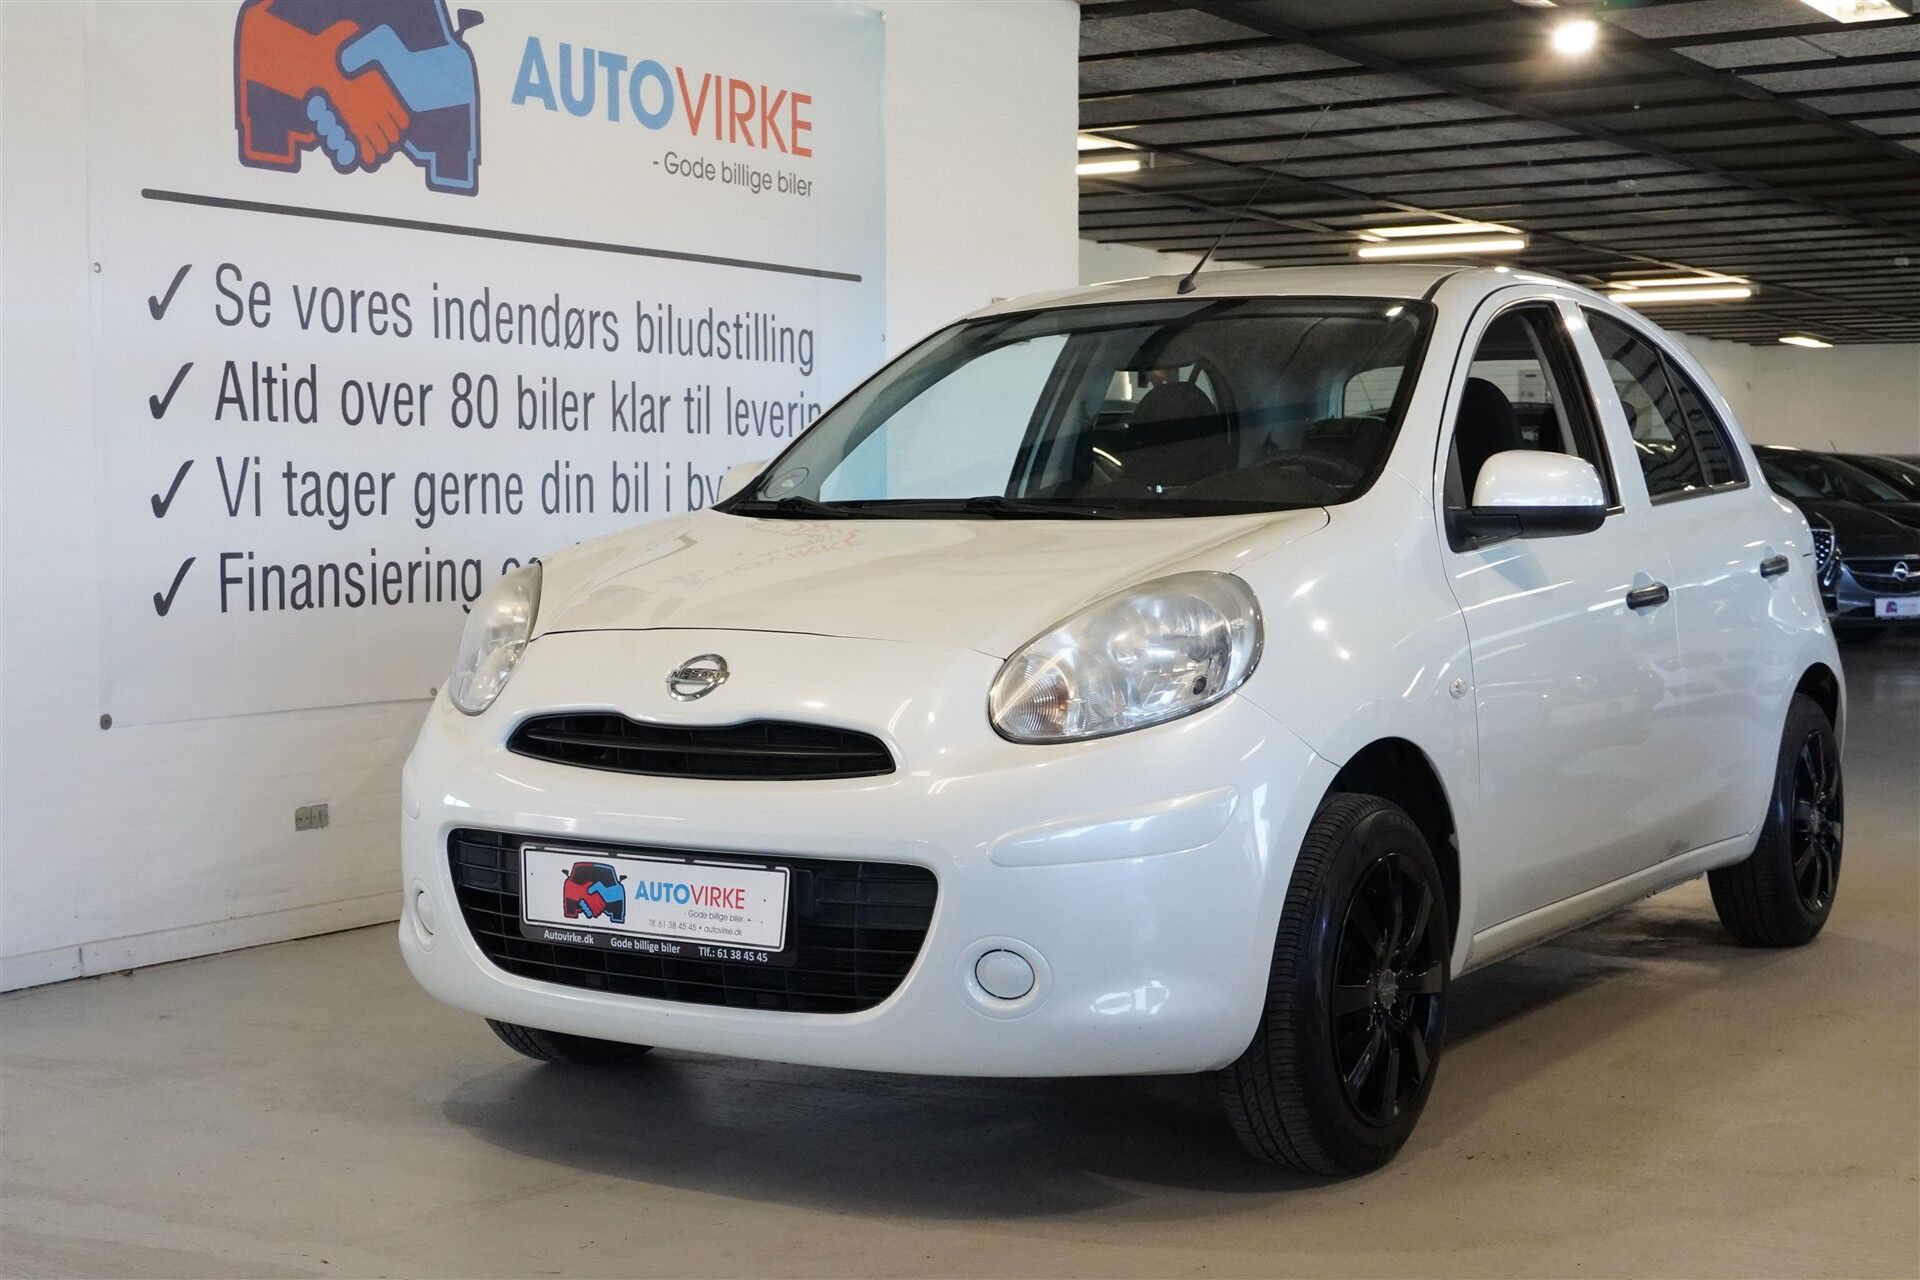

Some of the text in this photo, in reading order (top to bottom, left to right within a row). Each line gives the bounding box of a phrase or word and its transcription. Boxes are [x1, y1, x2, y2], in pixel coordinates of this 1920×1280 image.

[511, 35, 813, 158] AUTOVIRKE
[664, 151, 716, 181] Gode
[721, 160, 772, 194] billige
[777, 171, 813, 197] biler
[215, 262, 815, 377] Se vores indendørs biludstilling
[214, 360, 318, 425] Altid
[341, 379, 433, 426] over
[451, 371, 498, 430] 80
[517, 374, 595, 432] biler
[611, 380, 671, 434] klar
[684, 385, 711, 435] til
[215, 456, 261, 517] Vi
[282, 460, 395, 531] tager
[414, 471, 523, 529] gerne
[541, 460, 594, 514] din
[612, 460, 650, 514] bil
[665, 461, 671, 513] i
[219, 546, 482, 615] Finansiering
[634, 880, 746, 910] AUTOVIRKE
[688, 909, 744, 922] Gode billige biler
[543, 929, 768, 963] Autovirke.dk Gode billige biler Tlf.: 61 38 45 45
[657, 920, 666, 928] 61
[668, 921, 677, 929] 38
[678, 922, 687, 930] 45
[688, 923, 697, 931] 45
[703, 925, 742, 936] autovirke.dk
